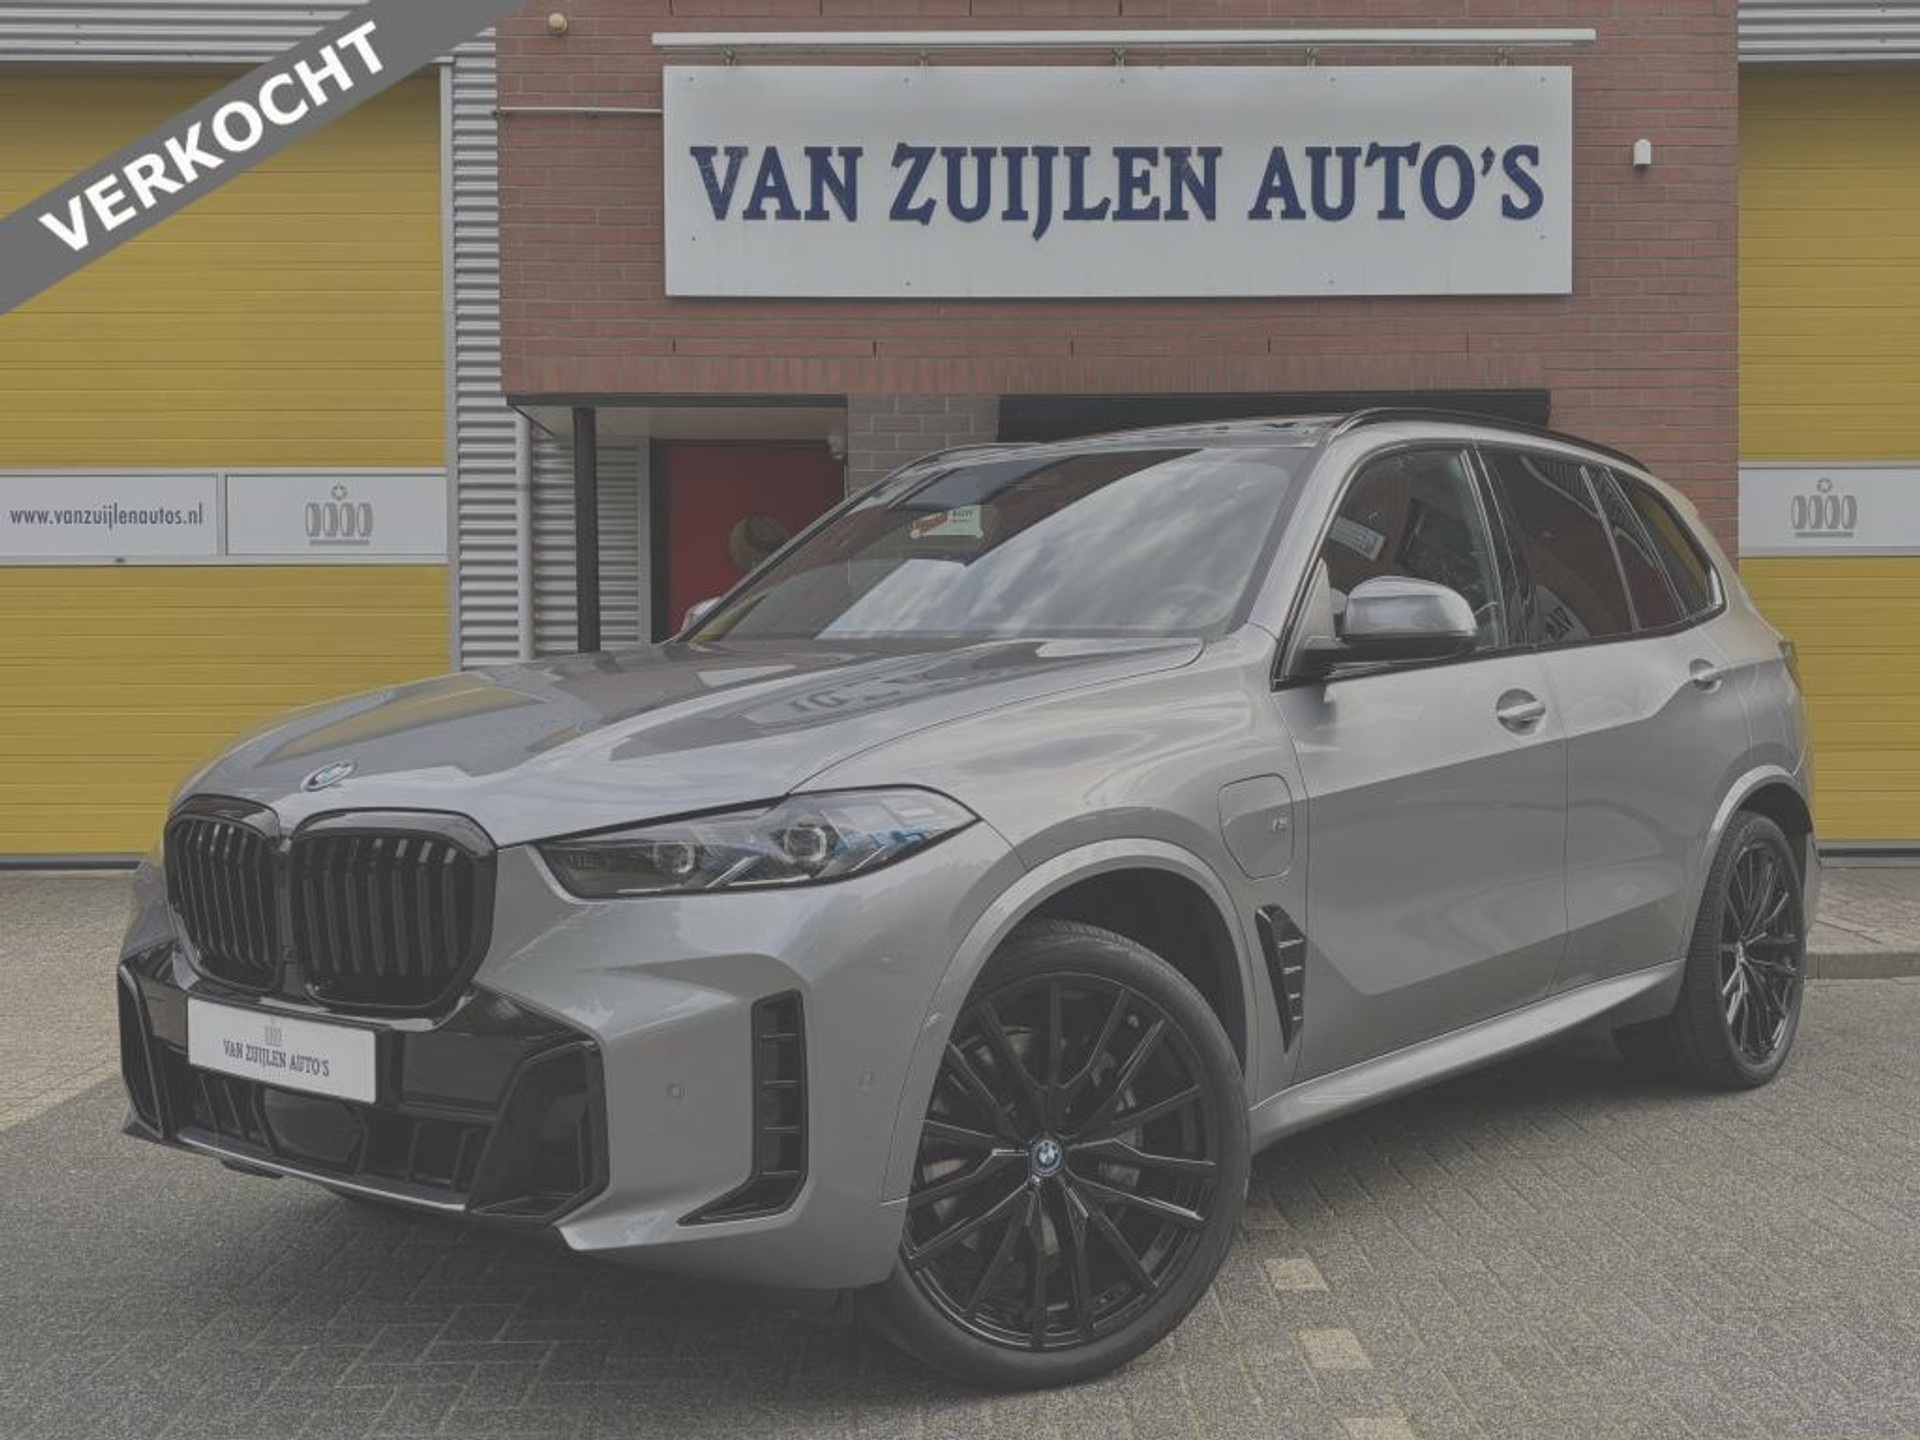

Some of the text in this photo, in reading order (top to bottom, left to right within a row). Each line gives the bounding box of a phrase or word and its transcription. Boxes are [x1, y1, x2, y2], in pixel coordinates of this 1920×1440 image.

[690, 142, 1545, 239] VAN ZUIJLEN AUTO'S
[9, 501, 204, 531] www.vanzuijlenautos.nl
[222, 1038, 330, 1077] VAN ZUIJLEN AUTO'S
